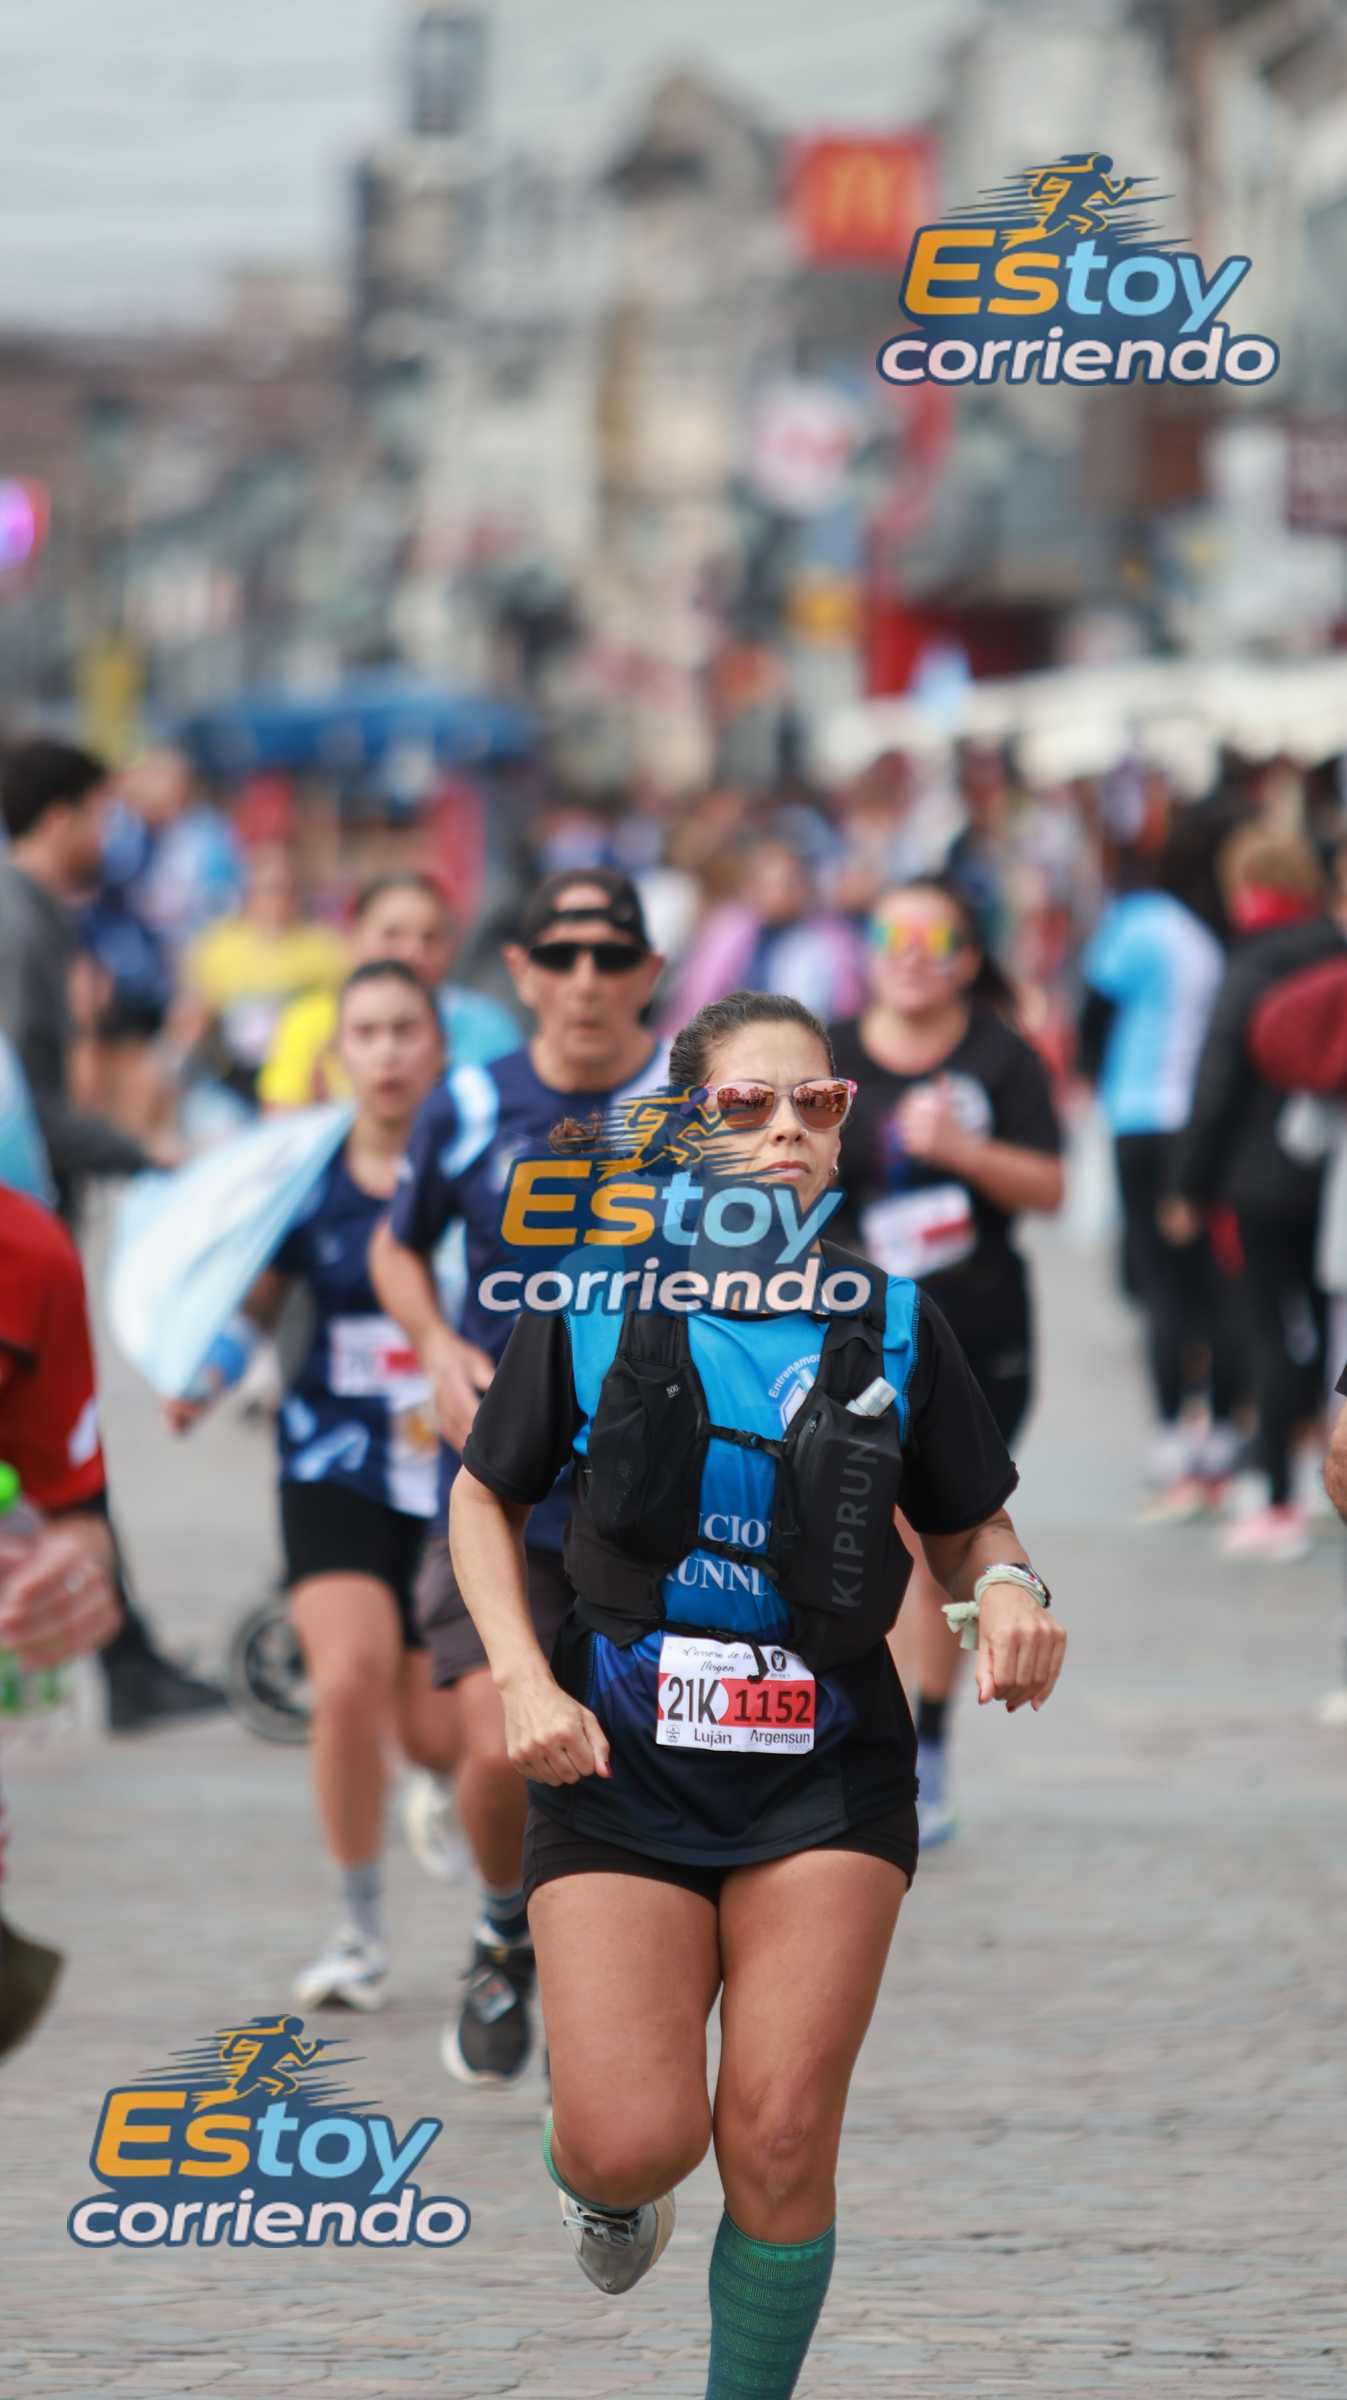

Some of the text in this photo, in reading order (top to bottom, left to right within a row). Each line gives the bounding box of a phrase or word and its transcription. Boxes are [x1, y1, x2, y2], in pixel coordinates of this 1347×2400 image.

[832, 1438, 879, 1608] KIPRUN
[668, 1676, 812, 1726] 21K 1152
[694, 1728, 732, 1746] Luján
[750, 1729, 810, 1745] Argensun
